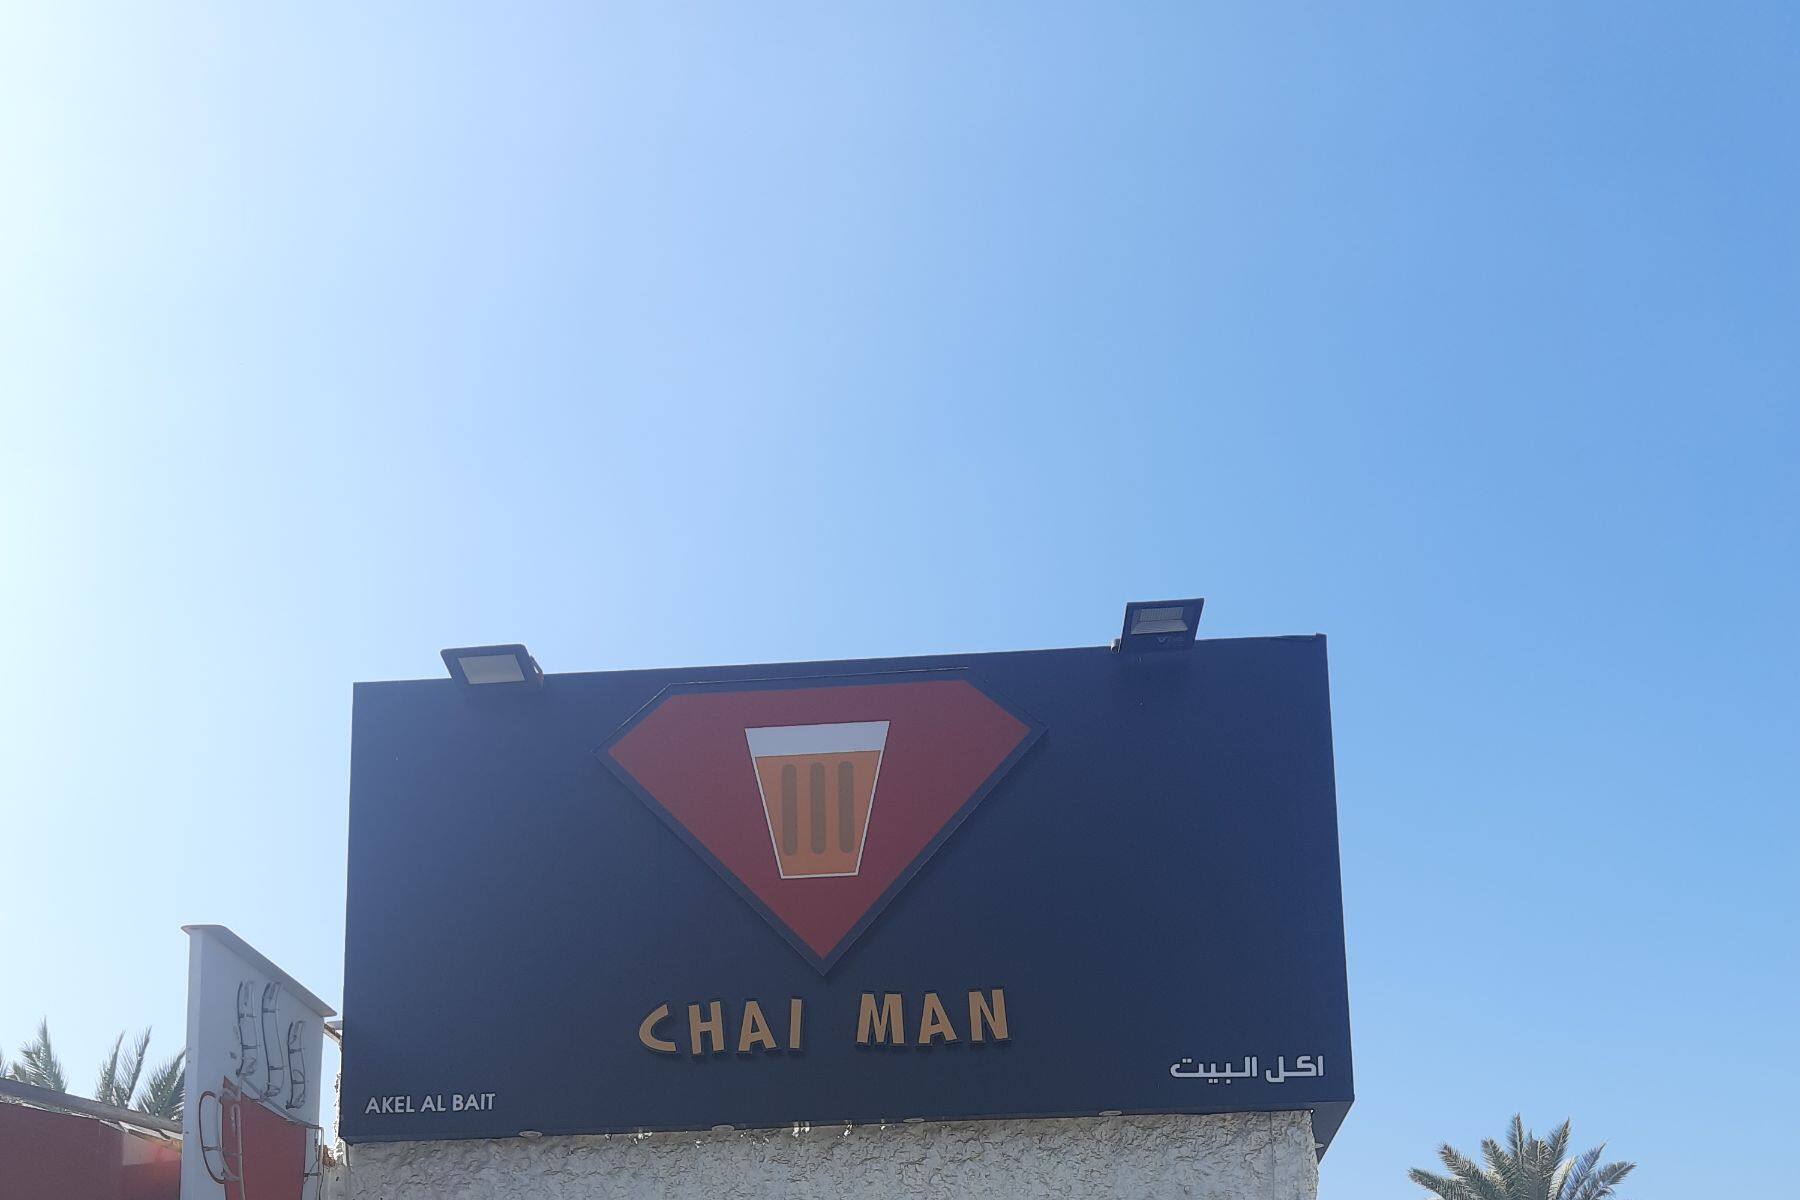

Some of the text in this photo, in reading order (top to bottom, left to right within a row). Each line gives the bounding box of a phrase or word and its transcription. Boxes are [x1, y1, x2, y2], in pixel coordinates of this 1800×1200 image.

[638, 988, 1009, 1055] CHAI MAN
[1169, 1055, 1324, 1084] اكل البيت
[364, 1092, 496, 1114] AKEL AL BAIT
